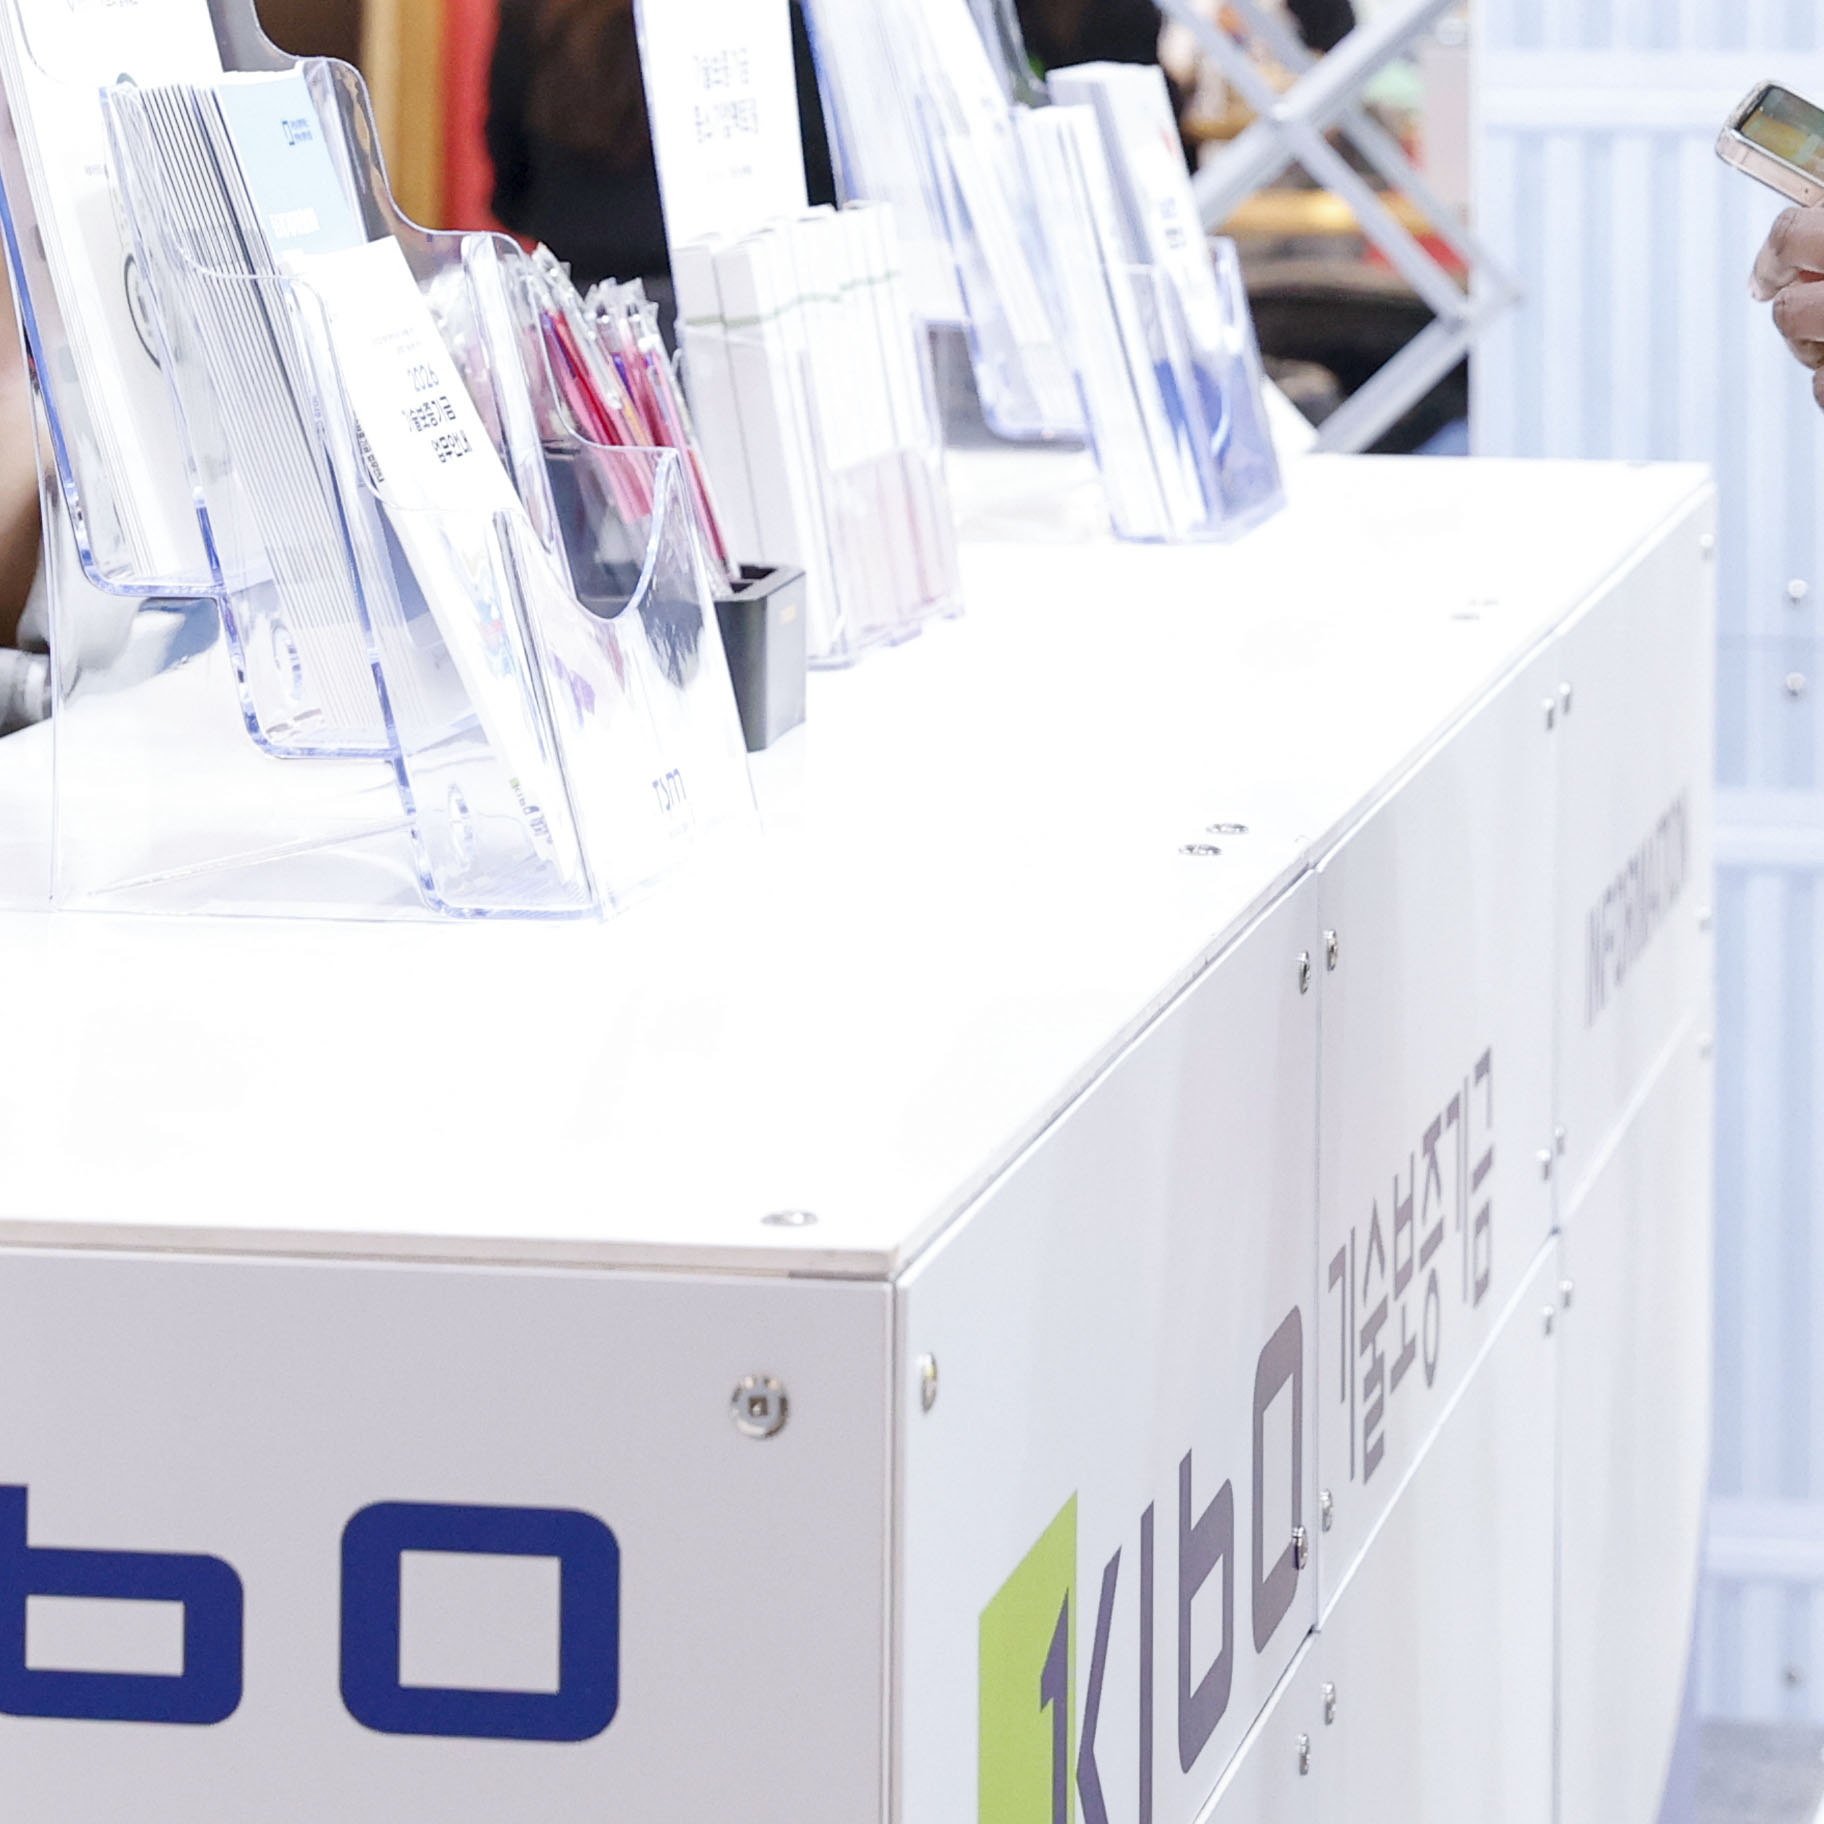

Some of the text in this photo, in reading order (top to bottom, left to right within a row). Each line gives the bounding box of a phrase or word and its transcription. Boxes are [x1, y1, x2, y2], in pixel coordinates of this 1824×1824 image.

[407, 362, 440, 392] 2026
[401, 395, 457, 432] 기술보증기금
[430, 429, 473, 464] 업무안내
[1327, 1044, 1496, 1486] 기술보증기금
